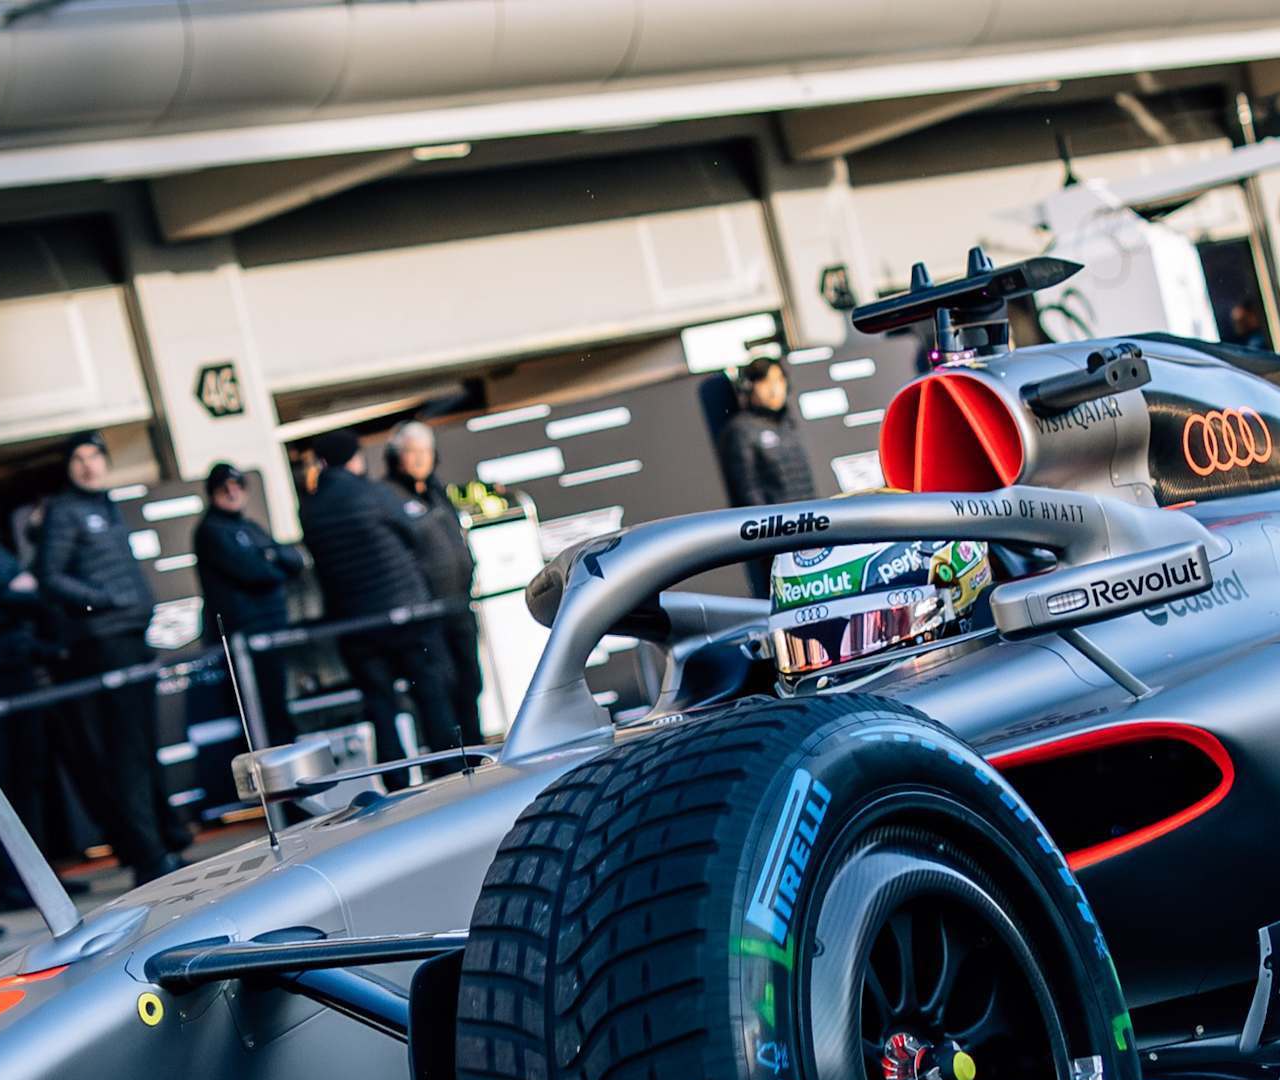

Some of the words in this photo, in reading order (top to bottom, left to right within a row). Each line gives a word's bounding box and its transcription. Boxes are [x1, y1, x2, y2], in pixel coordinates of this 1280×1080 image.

[739, 511, 831, 541] Gillette
[950, 498, 1013, 517] WORLD
[1019, 498, 1037, 519] OF
[1041, 502, 1084, 524] HYATT
[781, 571, 853, 604] Revolut
[1090, 557, 1202, 608] Revolut
[745, 767, 833, 945] PIRELLI
